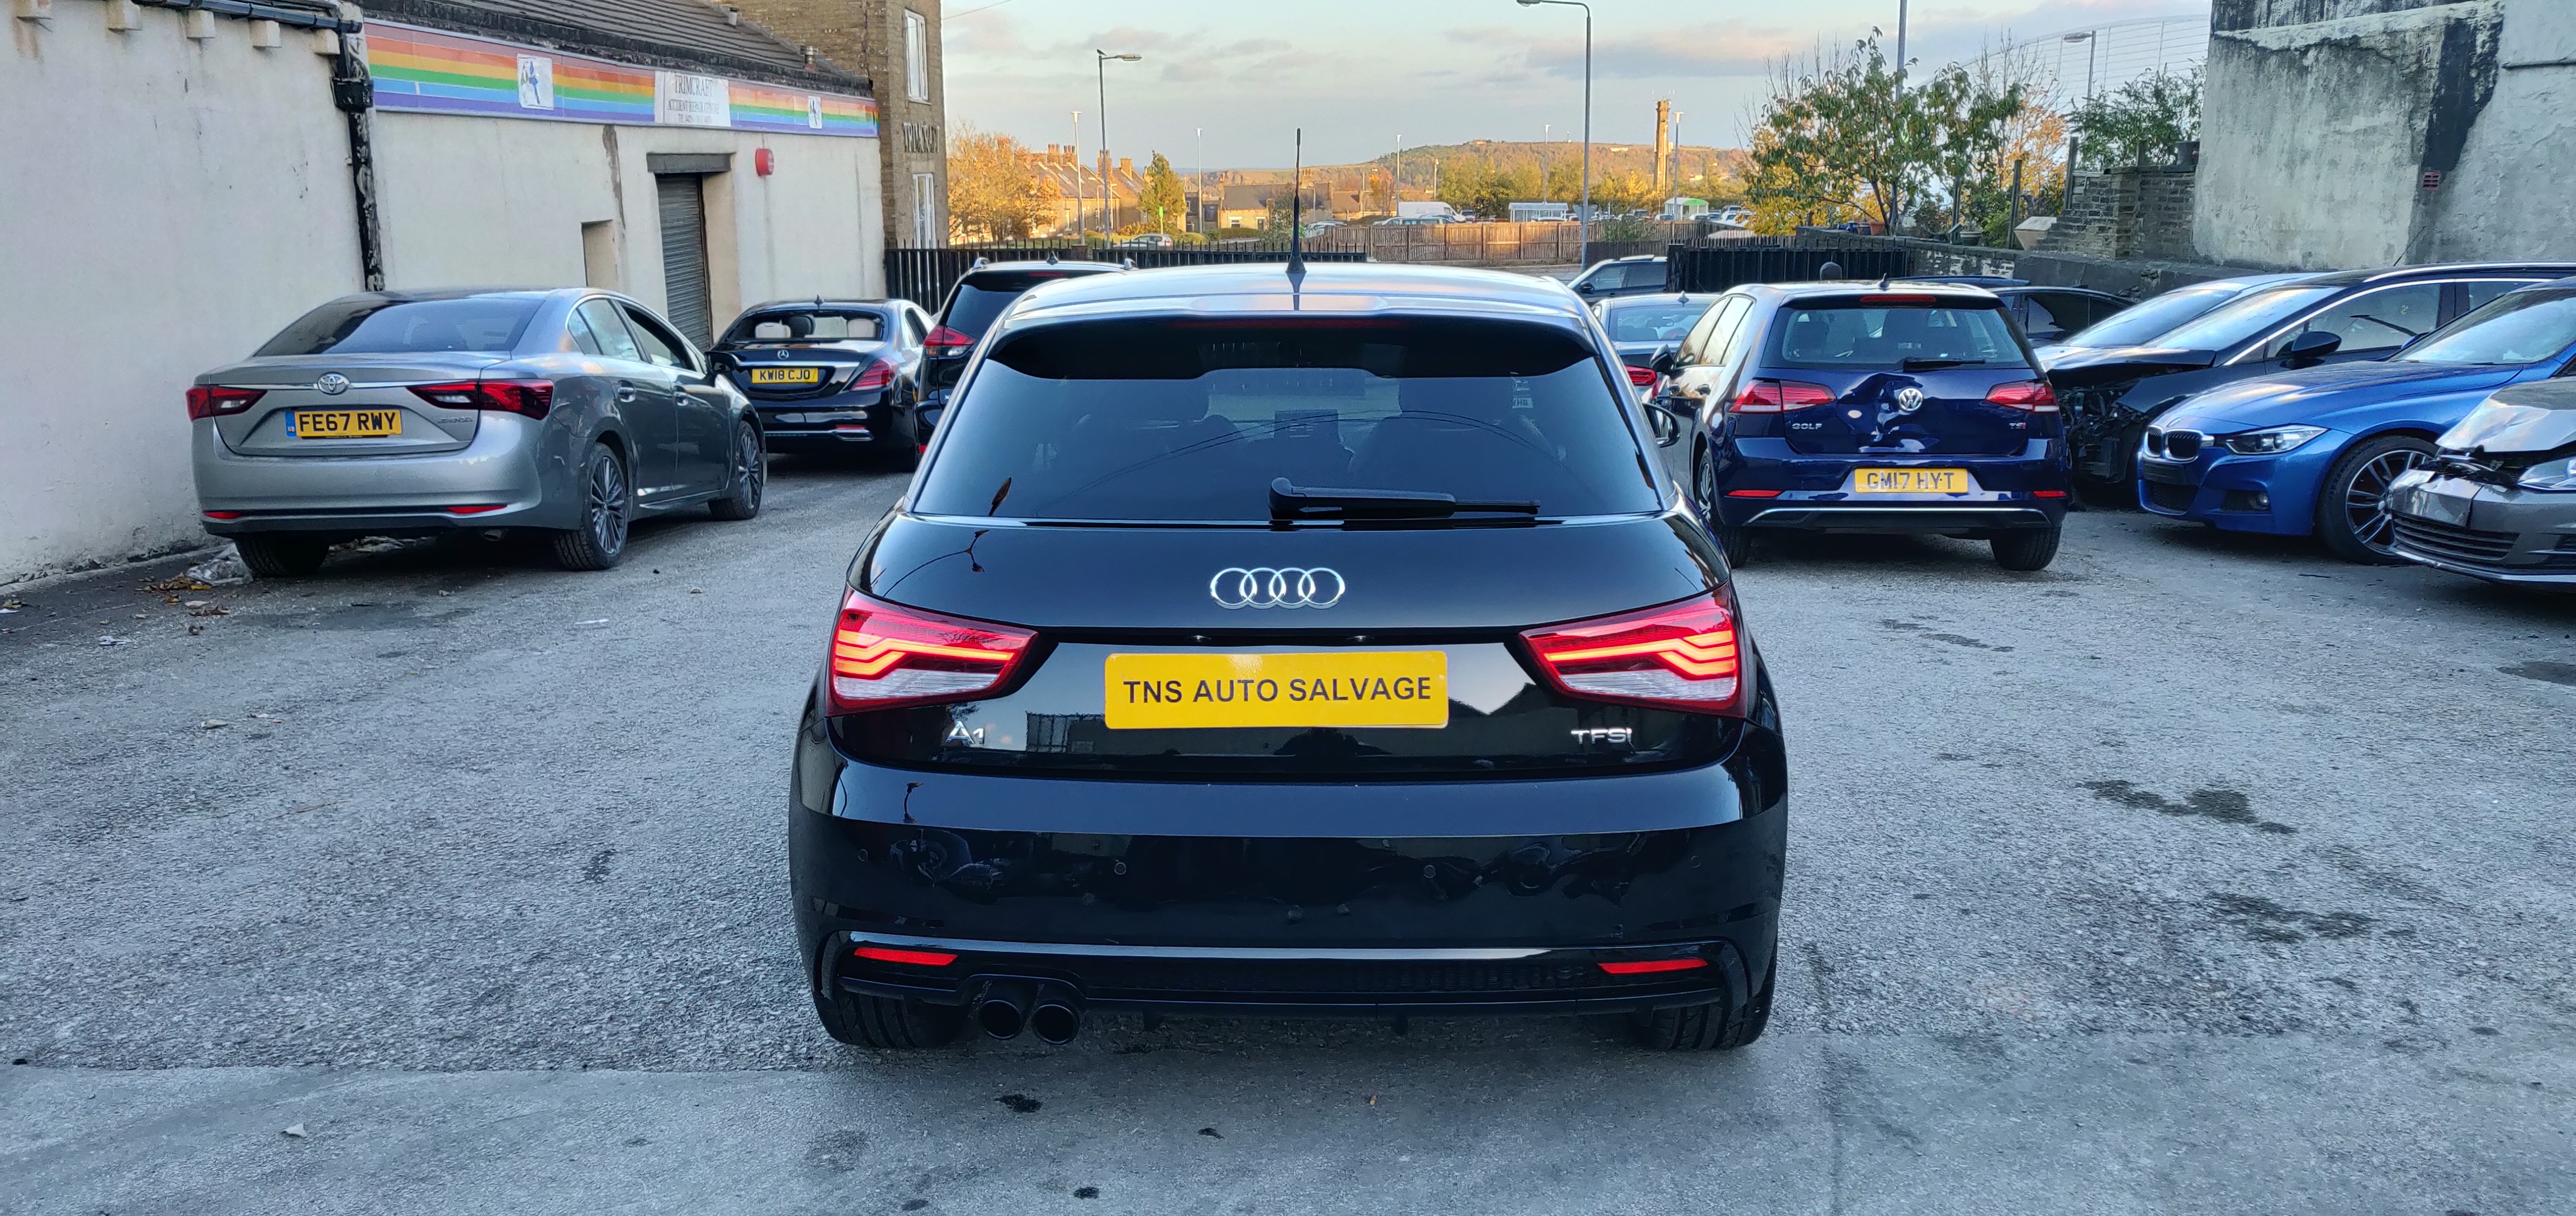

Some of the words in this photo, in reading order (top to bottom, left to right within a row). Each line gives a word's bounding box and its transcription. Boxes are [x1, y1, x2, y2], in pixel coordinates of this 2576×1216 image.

[675, 75, 713, 97] TRIMCRAFT
[760, 370, 784, 380] KW18
[299, 413, 351, 432] FE67
[357, 412, 396, 431] RWY
[1867, 472, 1910, 490] GM17
[1917, 472, 1954, 490] HYT
[1123, 680, 1182, 704] TNS
[1192, 678, 1278, 703] AUTO
[1289, 676, 1431, 702] SALVAGE
[946, 720, 984, 744] A1
[1570, 728, 1632, 744] TFSI
